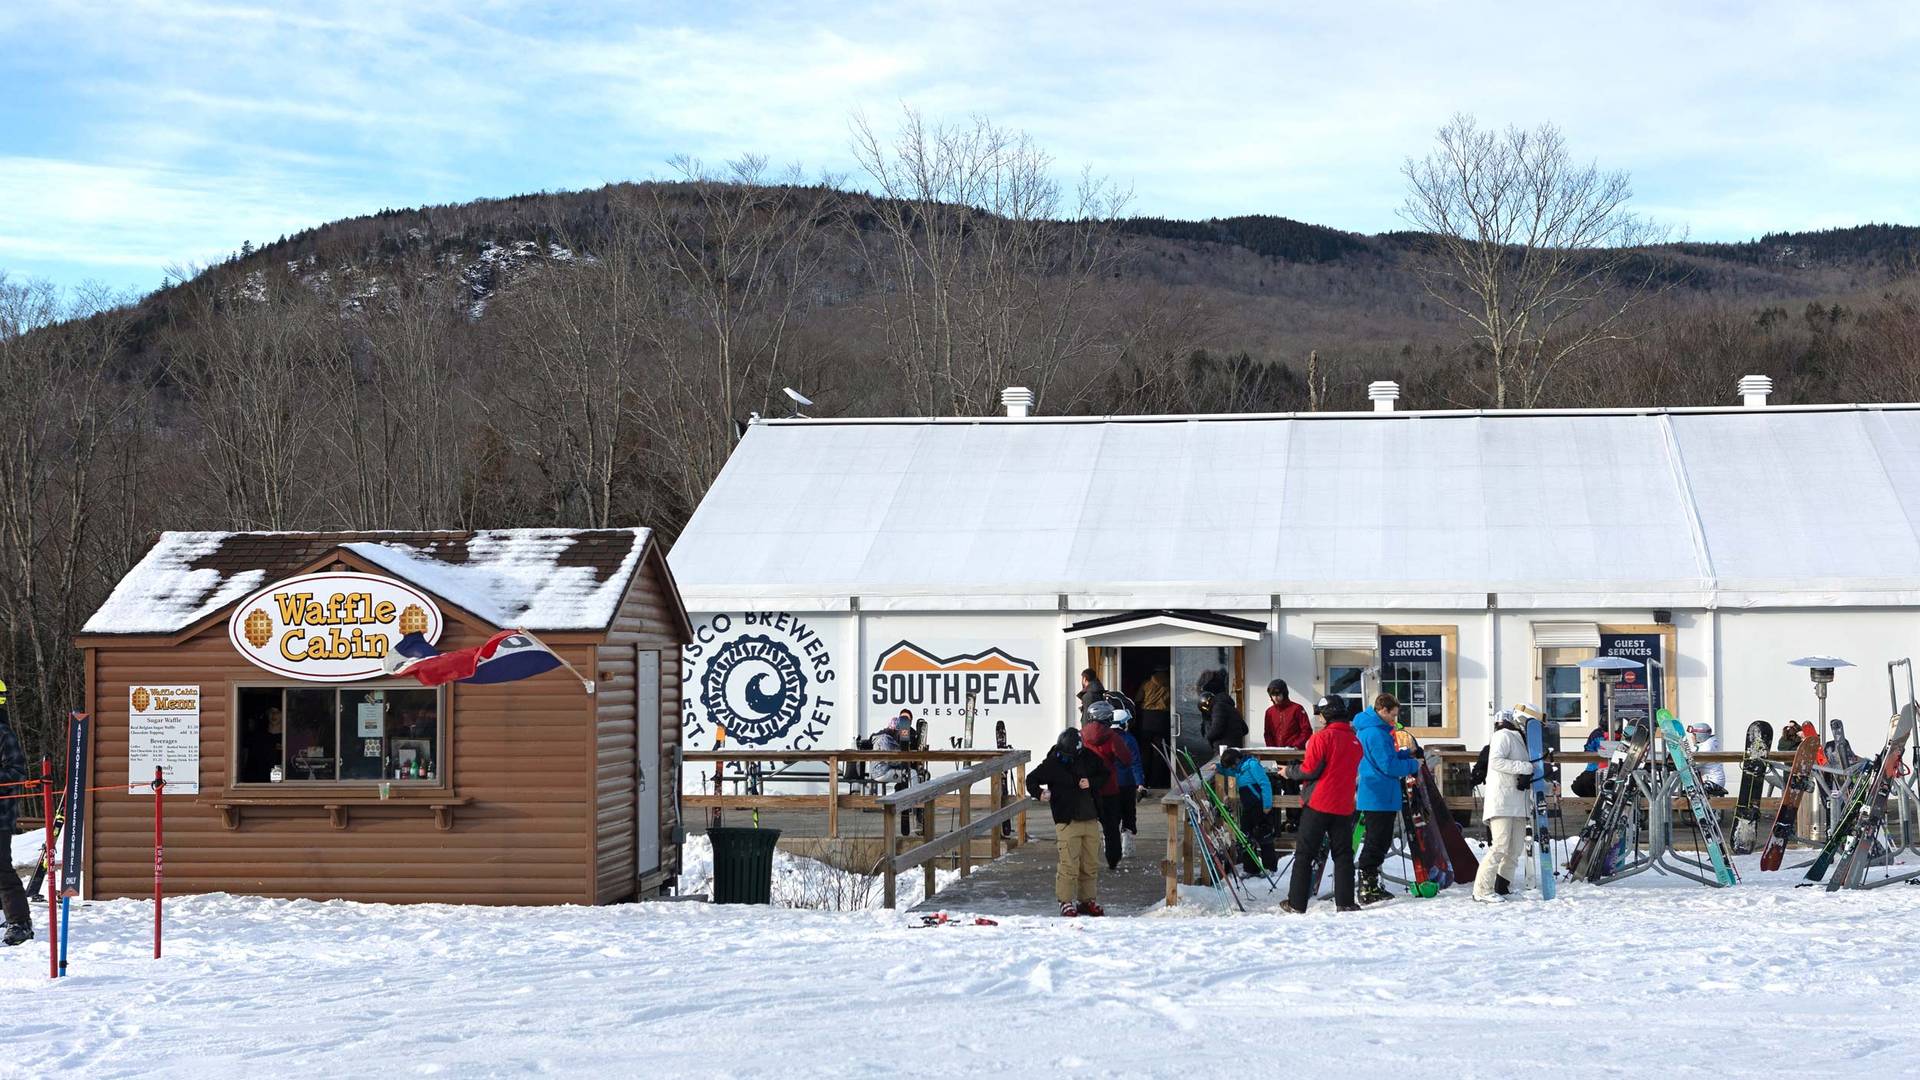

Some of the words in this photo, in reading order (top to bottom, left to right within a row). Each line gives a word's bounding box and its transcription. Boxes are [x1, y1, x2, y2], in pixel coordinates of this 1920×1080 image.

[274, 593, 397, 626] Waffle
[280, 628, 389, 661] Cabin
[745, 612, 835, 684] BREWERS
[1396, 640, 1427, 649] GUEST
[1614, 640, 1645, 648] GUEST
[1389, 648, 1433, 657] SERVICES
[1607, 648, 1652, 656] SERVICES
[149, 688, 174, 696] Waffle
[873, 673, 960, 705] SOUTH
[966, 673, 1041, 705] PEAK
[154, 696, 196, 711] Menu
[923, 708, 990, 716] RESORT
[73, 723, 82, 800] AUTHORIZED
[69, 801, 78, 873] PERSONNEL
[65, 877, 77, 885] ONLY
